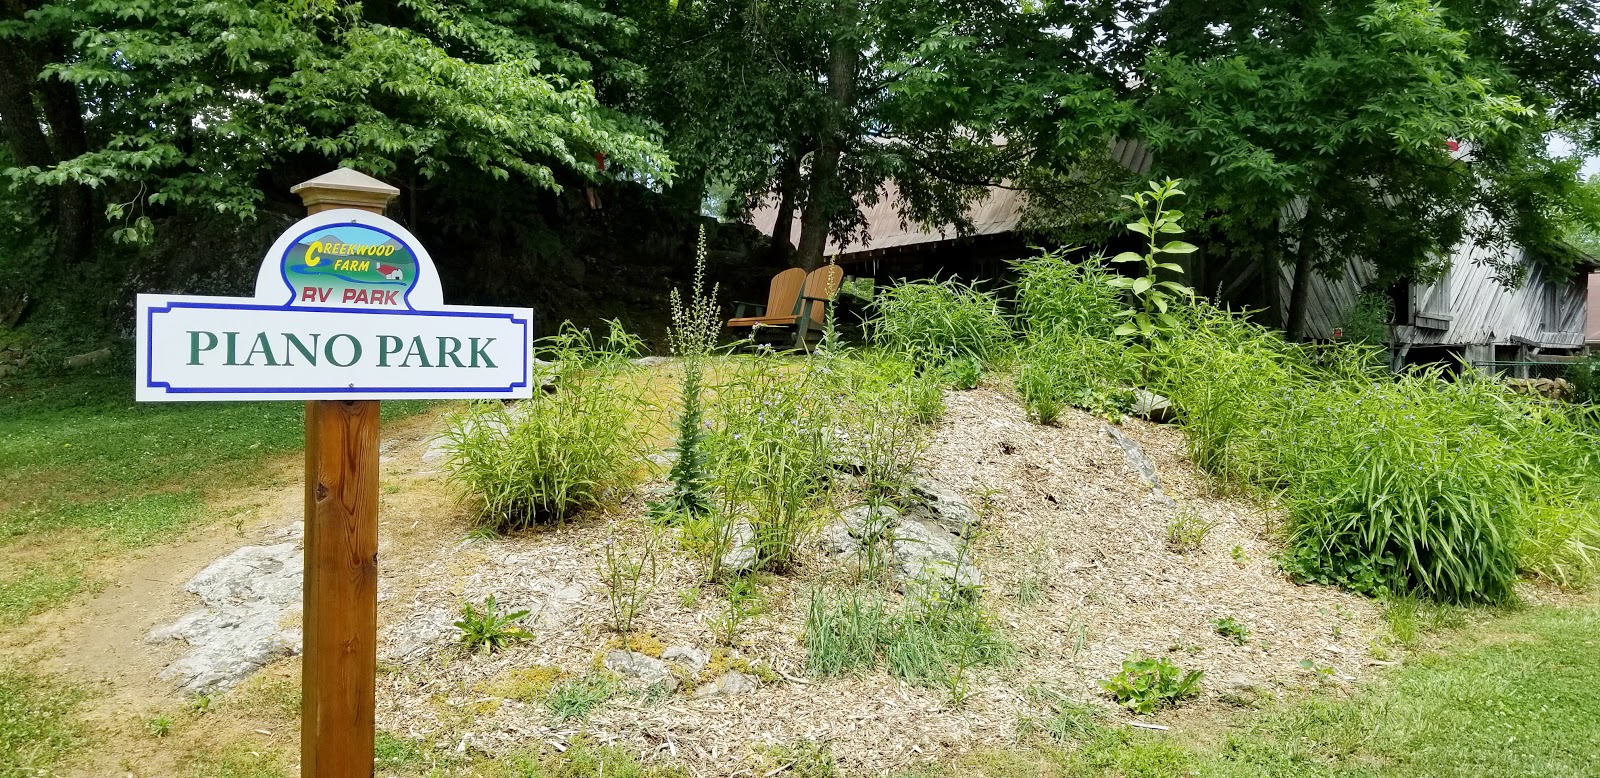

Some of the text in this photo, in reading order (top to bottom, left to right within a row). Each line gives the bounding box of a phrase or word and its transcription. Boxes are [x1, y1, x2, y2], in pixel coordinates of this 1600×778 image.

[304, 241, 395, 267] CREEKWOOD
[334, 259, 371, 272] FARM
[301, 286, 399, 305] RV PARK
[185, 330, 499, 369] PIANO PARK
